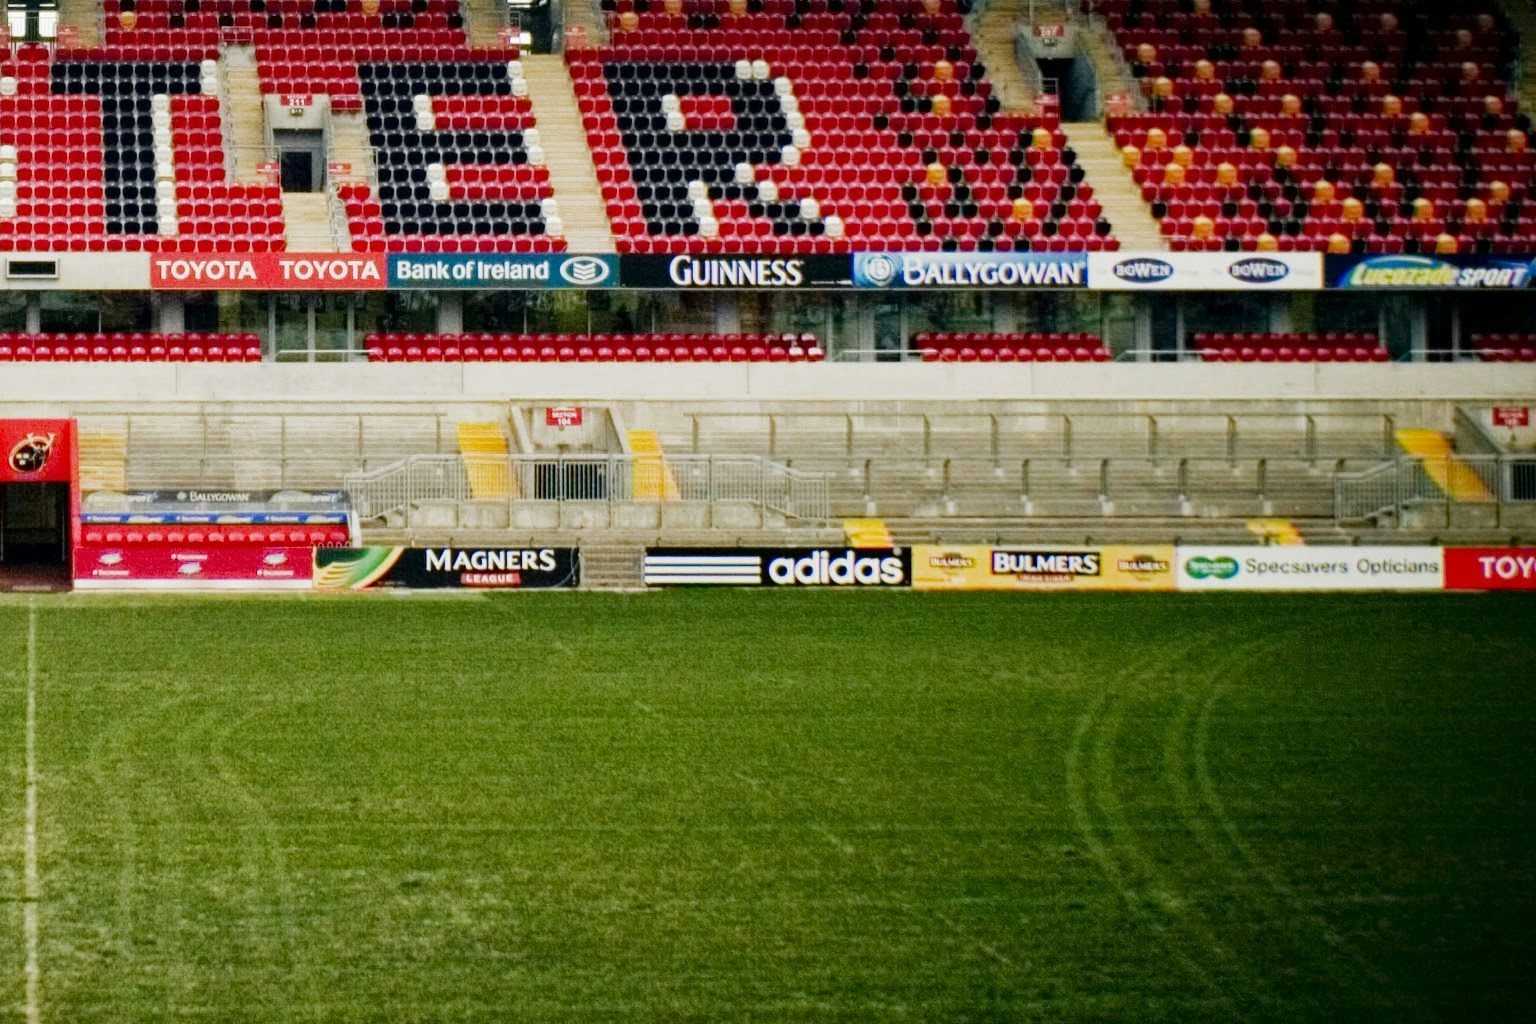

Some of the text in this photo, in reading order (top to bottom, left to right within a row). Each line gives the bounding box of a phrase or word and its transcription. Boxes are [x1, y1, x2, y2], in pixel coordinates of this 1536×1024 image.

[156, 260, 380, 280] TOYOTA TOYOTA
[397, 261, 549, 280] Bank of Ireland
[669, 255, 804, 286] GUINNESS
[902, 255, 1083, 285] BALLYGOWAN
[1116, 263, 1170, 277] BOWEN
[1231, 263, 1285, 277] BOWEN
[1459, 268, 1528, 286] SPORT
[189, 491, 249, 501] BALLYGOWAN
[425, 549, 556, 572] MAGNERS
[769, 550, 904, 585] adidas
[993, 553, 1099, 573] BULMERS
[1245, 558, 1348, 575] Specsavers
[1357, 558, 1440, 575] Opticians
[1478, 556, 1536, 579] TOY
[466, 574, 513, 583] LEAGUE
